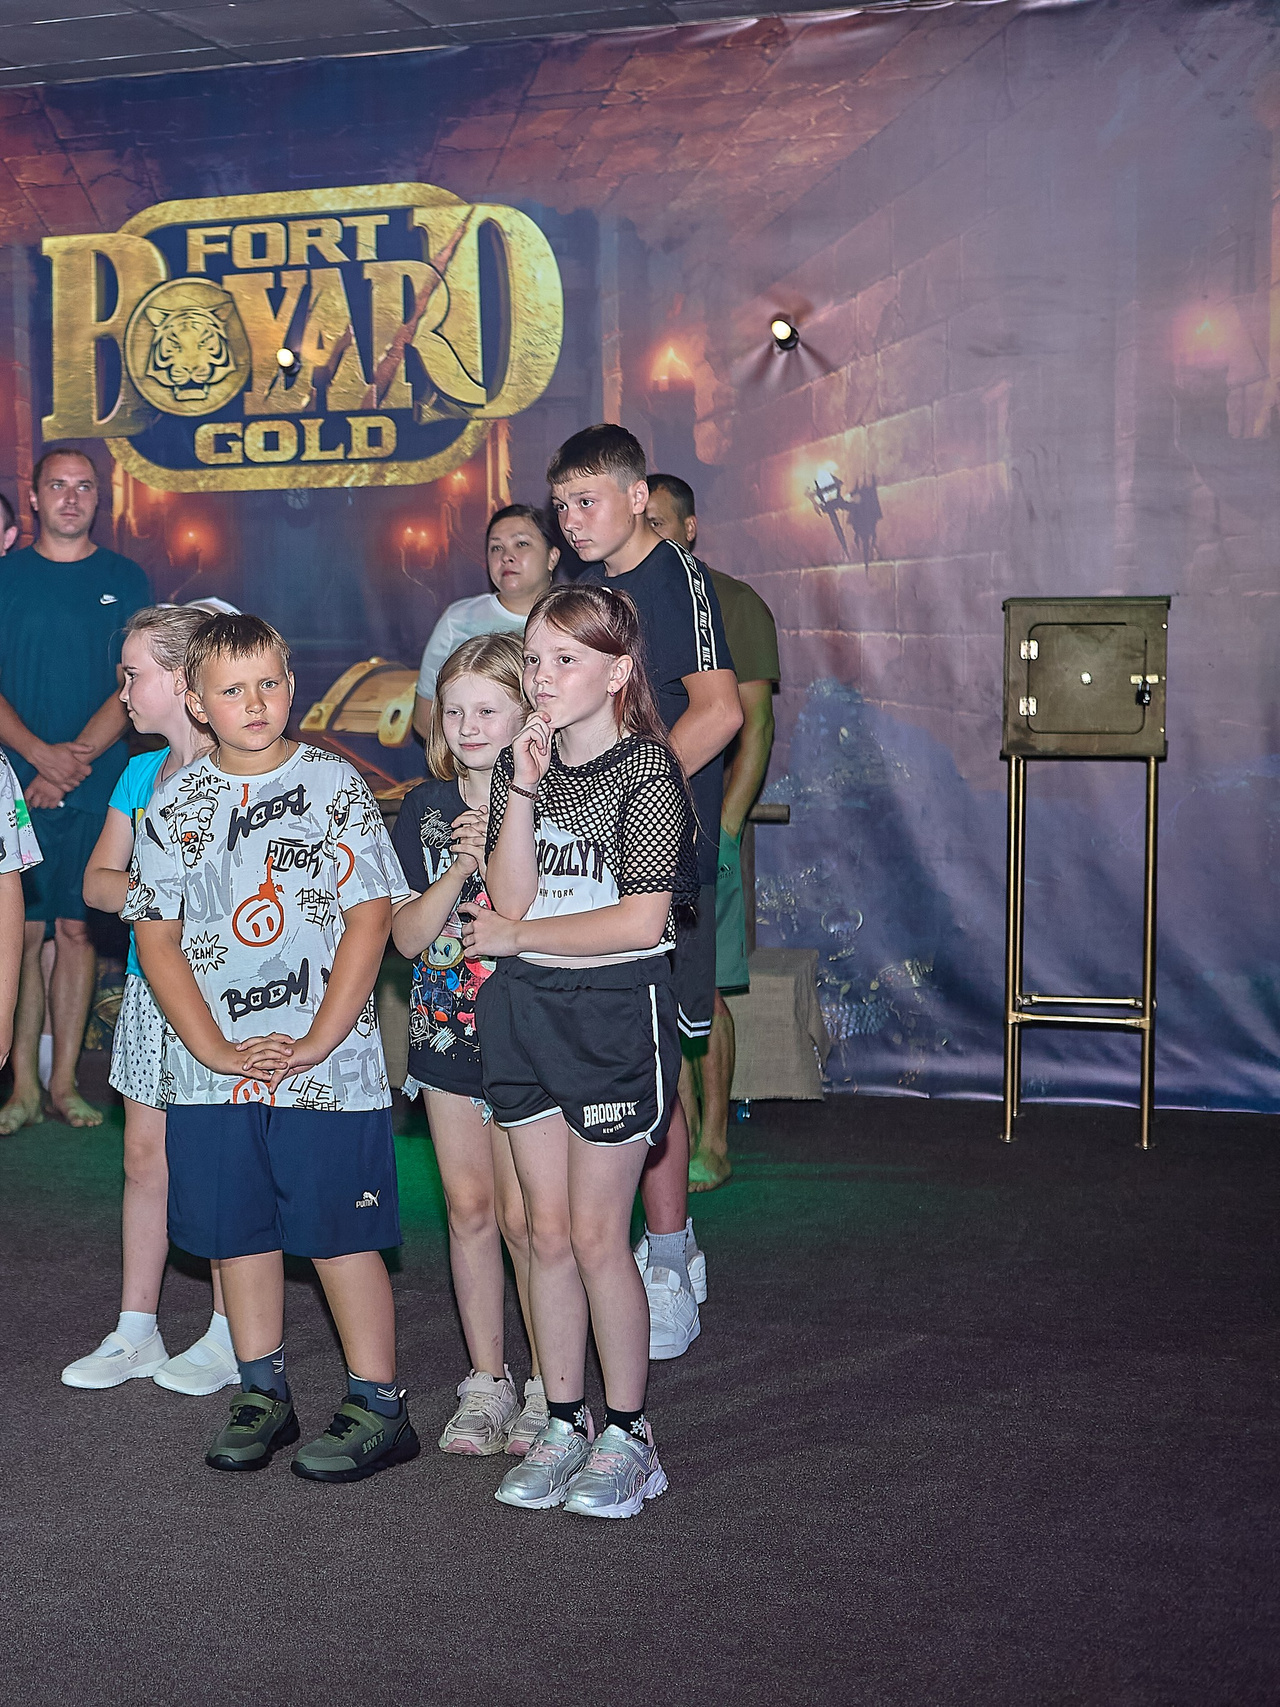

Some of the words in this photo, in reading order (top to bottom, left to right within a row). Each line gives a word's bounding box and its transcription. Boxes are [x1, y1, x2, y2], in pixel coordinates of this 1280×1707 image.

[186, 214, 390, 273] FORT
[41, 203, 564, 441] BOYARD
[194, 415, 398, 466] GOLD
[699, 610, 708, 629] NIKE
[701, 645, 711, 664] NIKE
[227, 784, 311, 851] BOOM
[264, 840, 324, 879] YOUTH
[552, 887, 574, 899] YORK
[192, 944, 214, 960] YEAH!
[220, 957, 309, 1022] BOOM
[331, 1047, 380, 1106] FU
